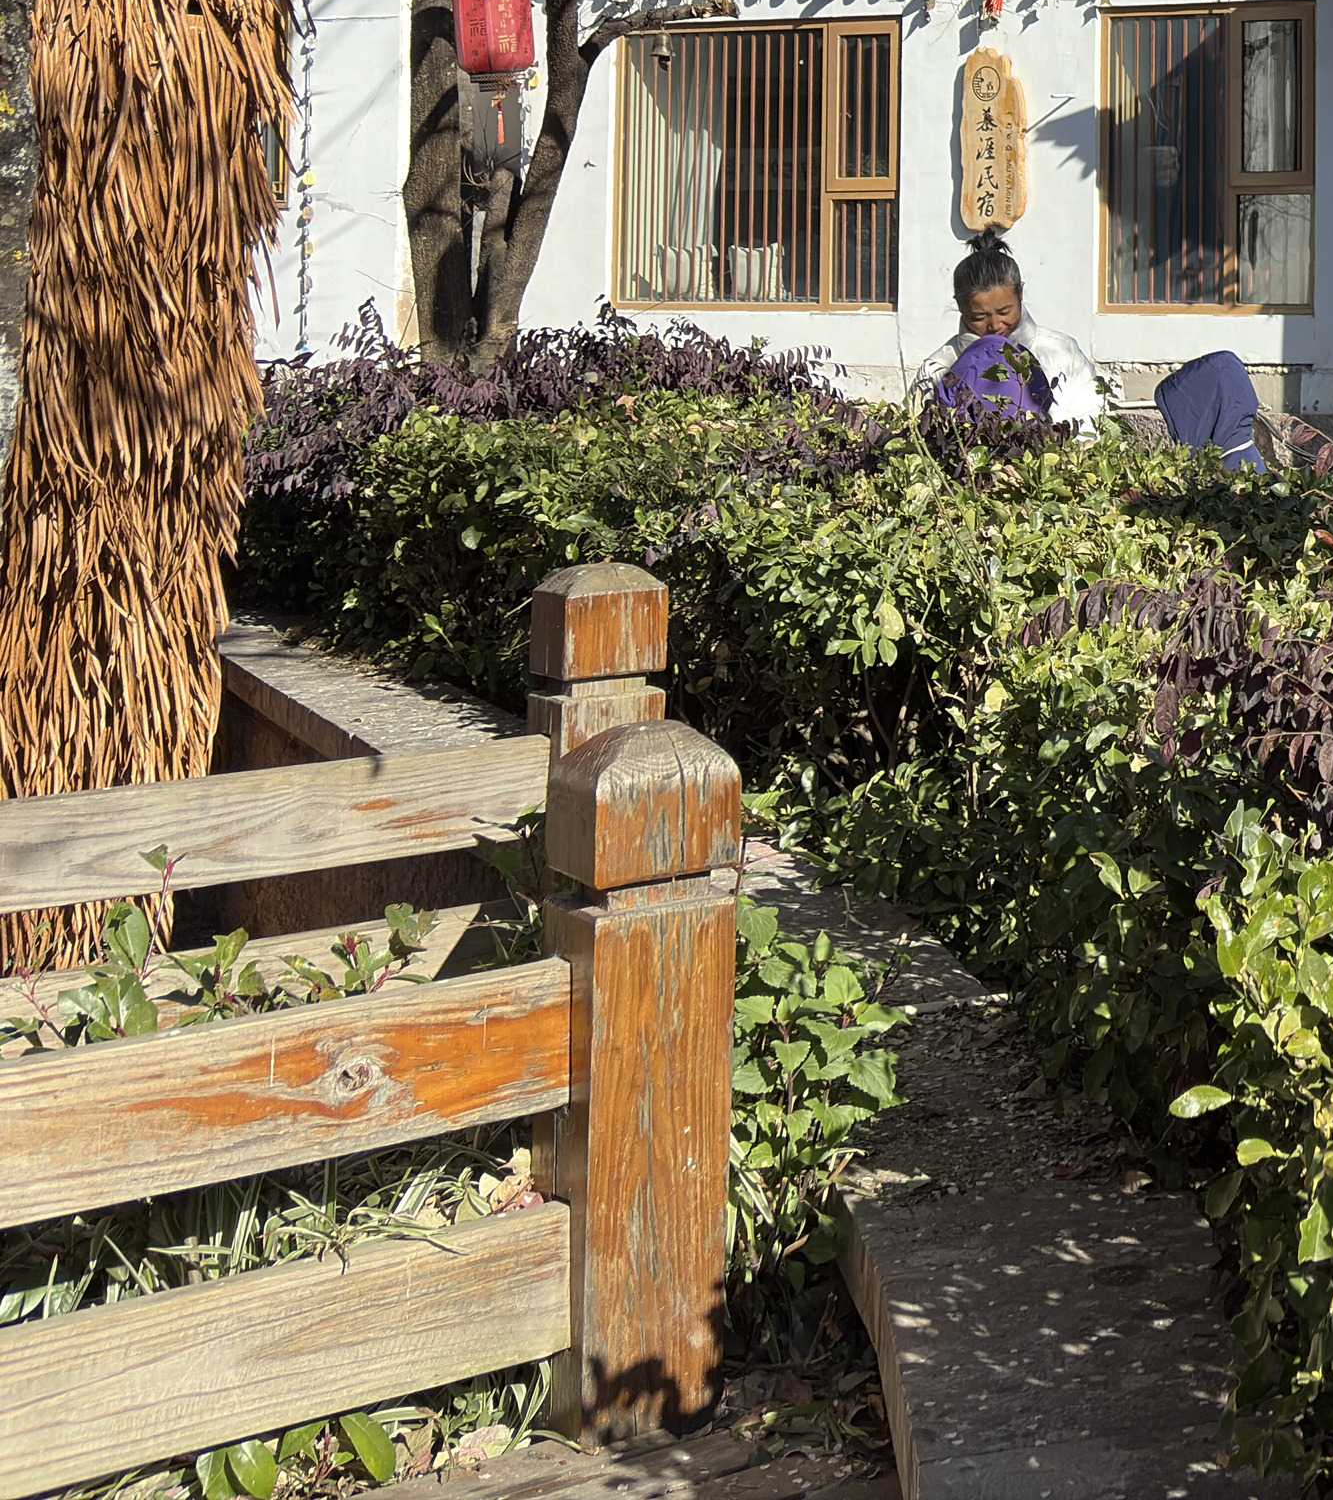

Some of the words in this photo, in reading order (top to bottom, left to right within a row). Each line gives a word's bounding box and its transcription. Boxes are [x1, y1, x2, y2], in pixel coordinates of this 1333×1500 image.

[498, 33, 517, 54] 福
[975, 106, 998, 218] 慕涯民宿
